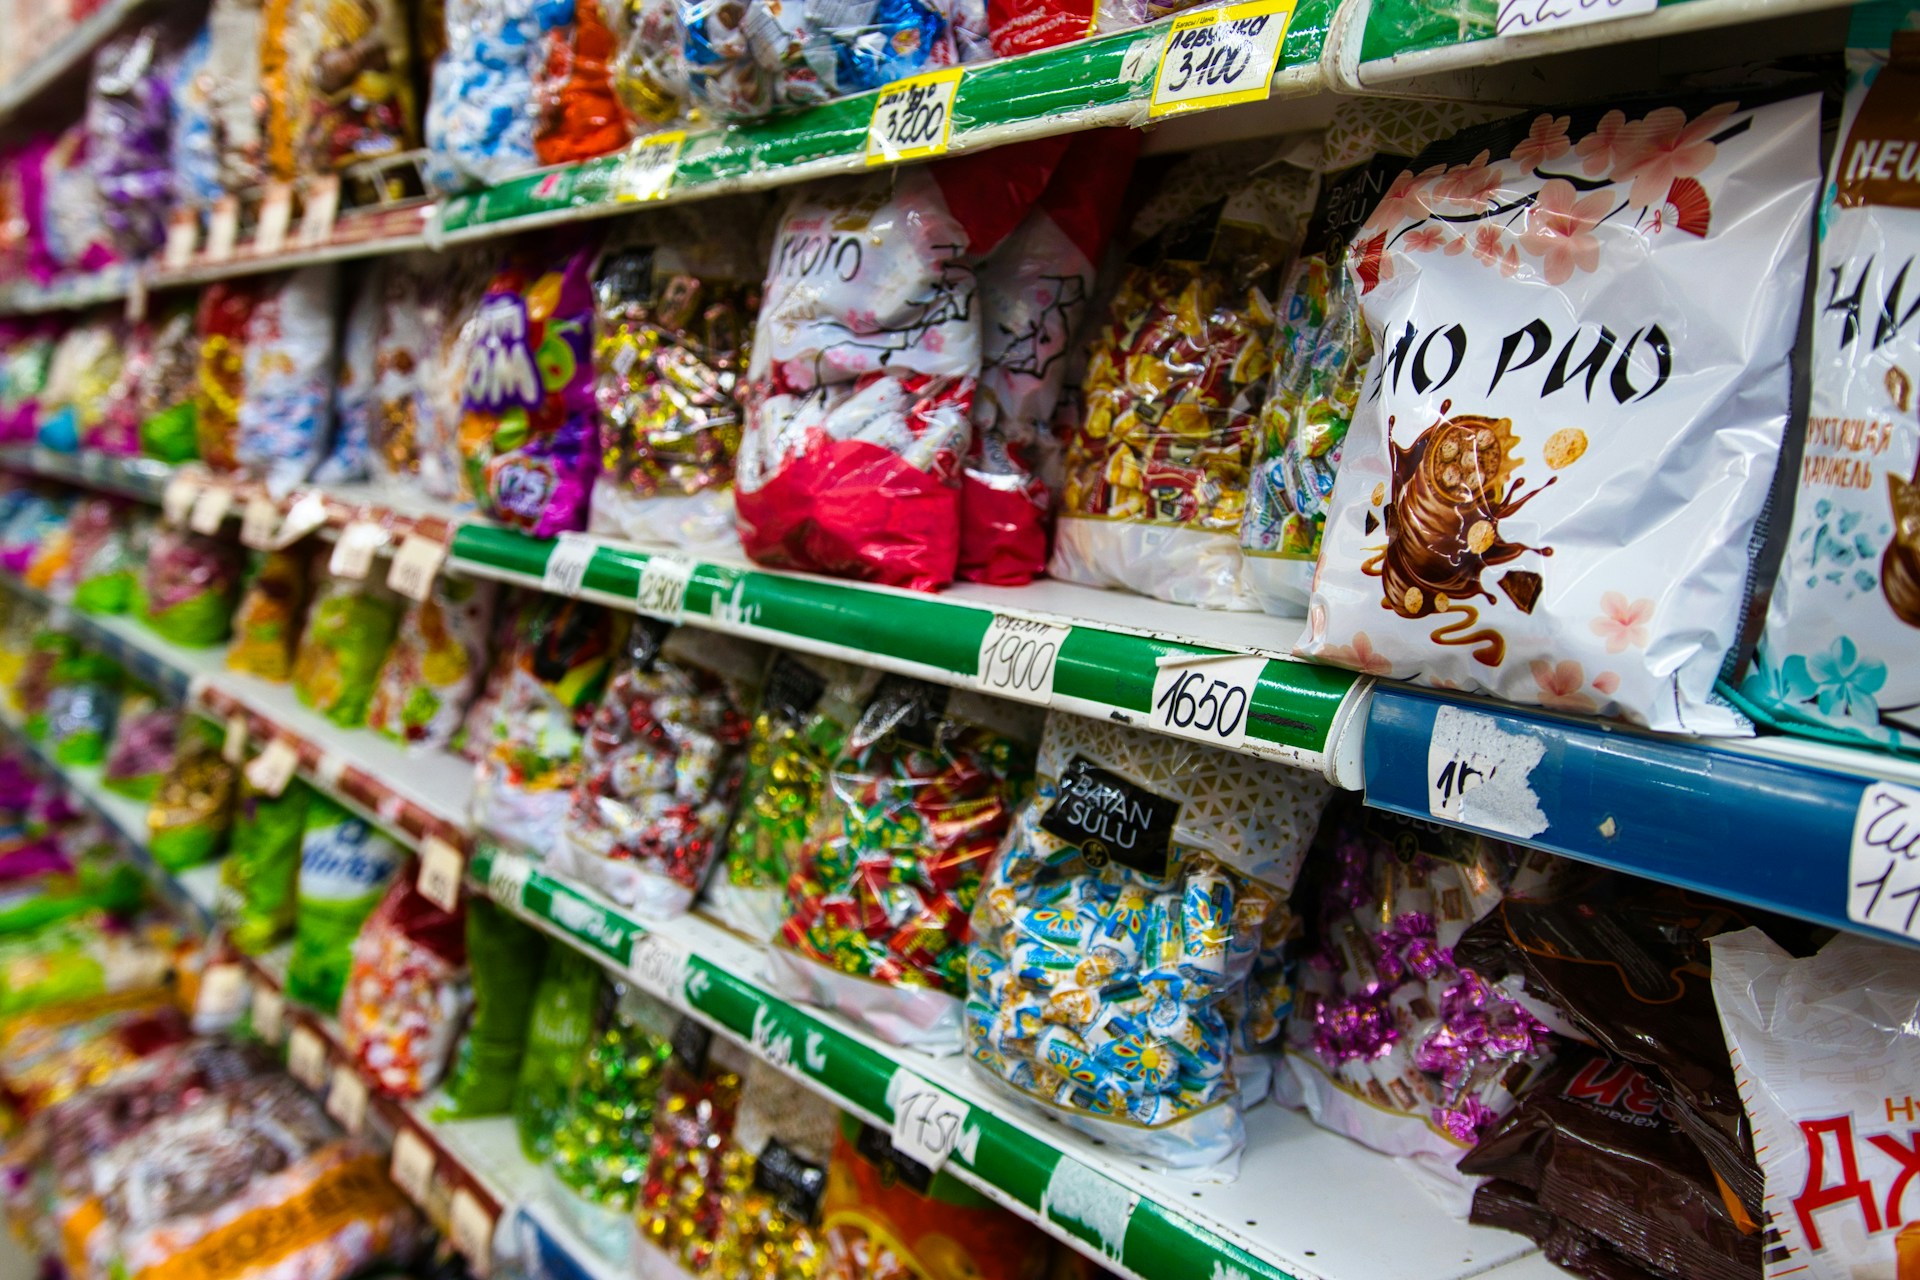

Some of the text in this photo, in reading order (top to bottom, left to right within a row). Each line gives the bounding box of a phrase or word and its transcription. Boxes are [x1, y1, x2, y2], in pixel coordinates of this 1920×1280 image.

[1168, 46, 1252, 92] 3100
[1486, 317, 1672, 405] РИО
[984, 632, 1056, 691] 1900
[1157, 669, 1247, 737] 1650
[1066, 801, 1138, 849] SULU
